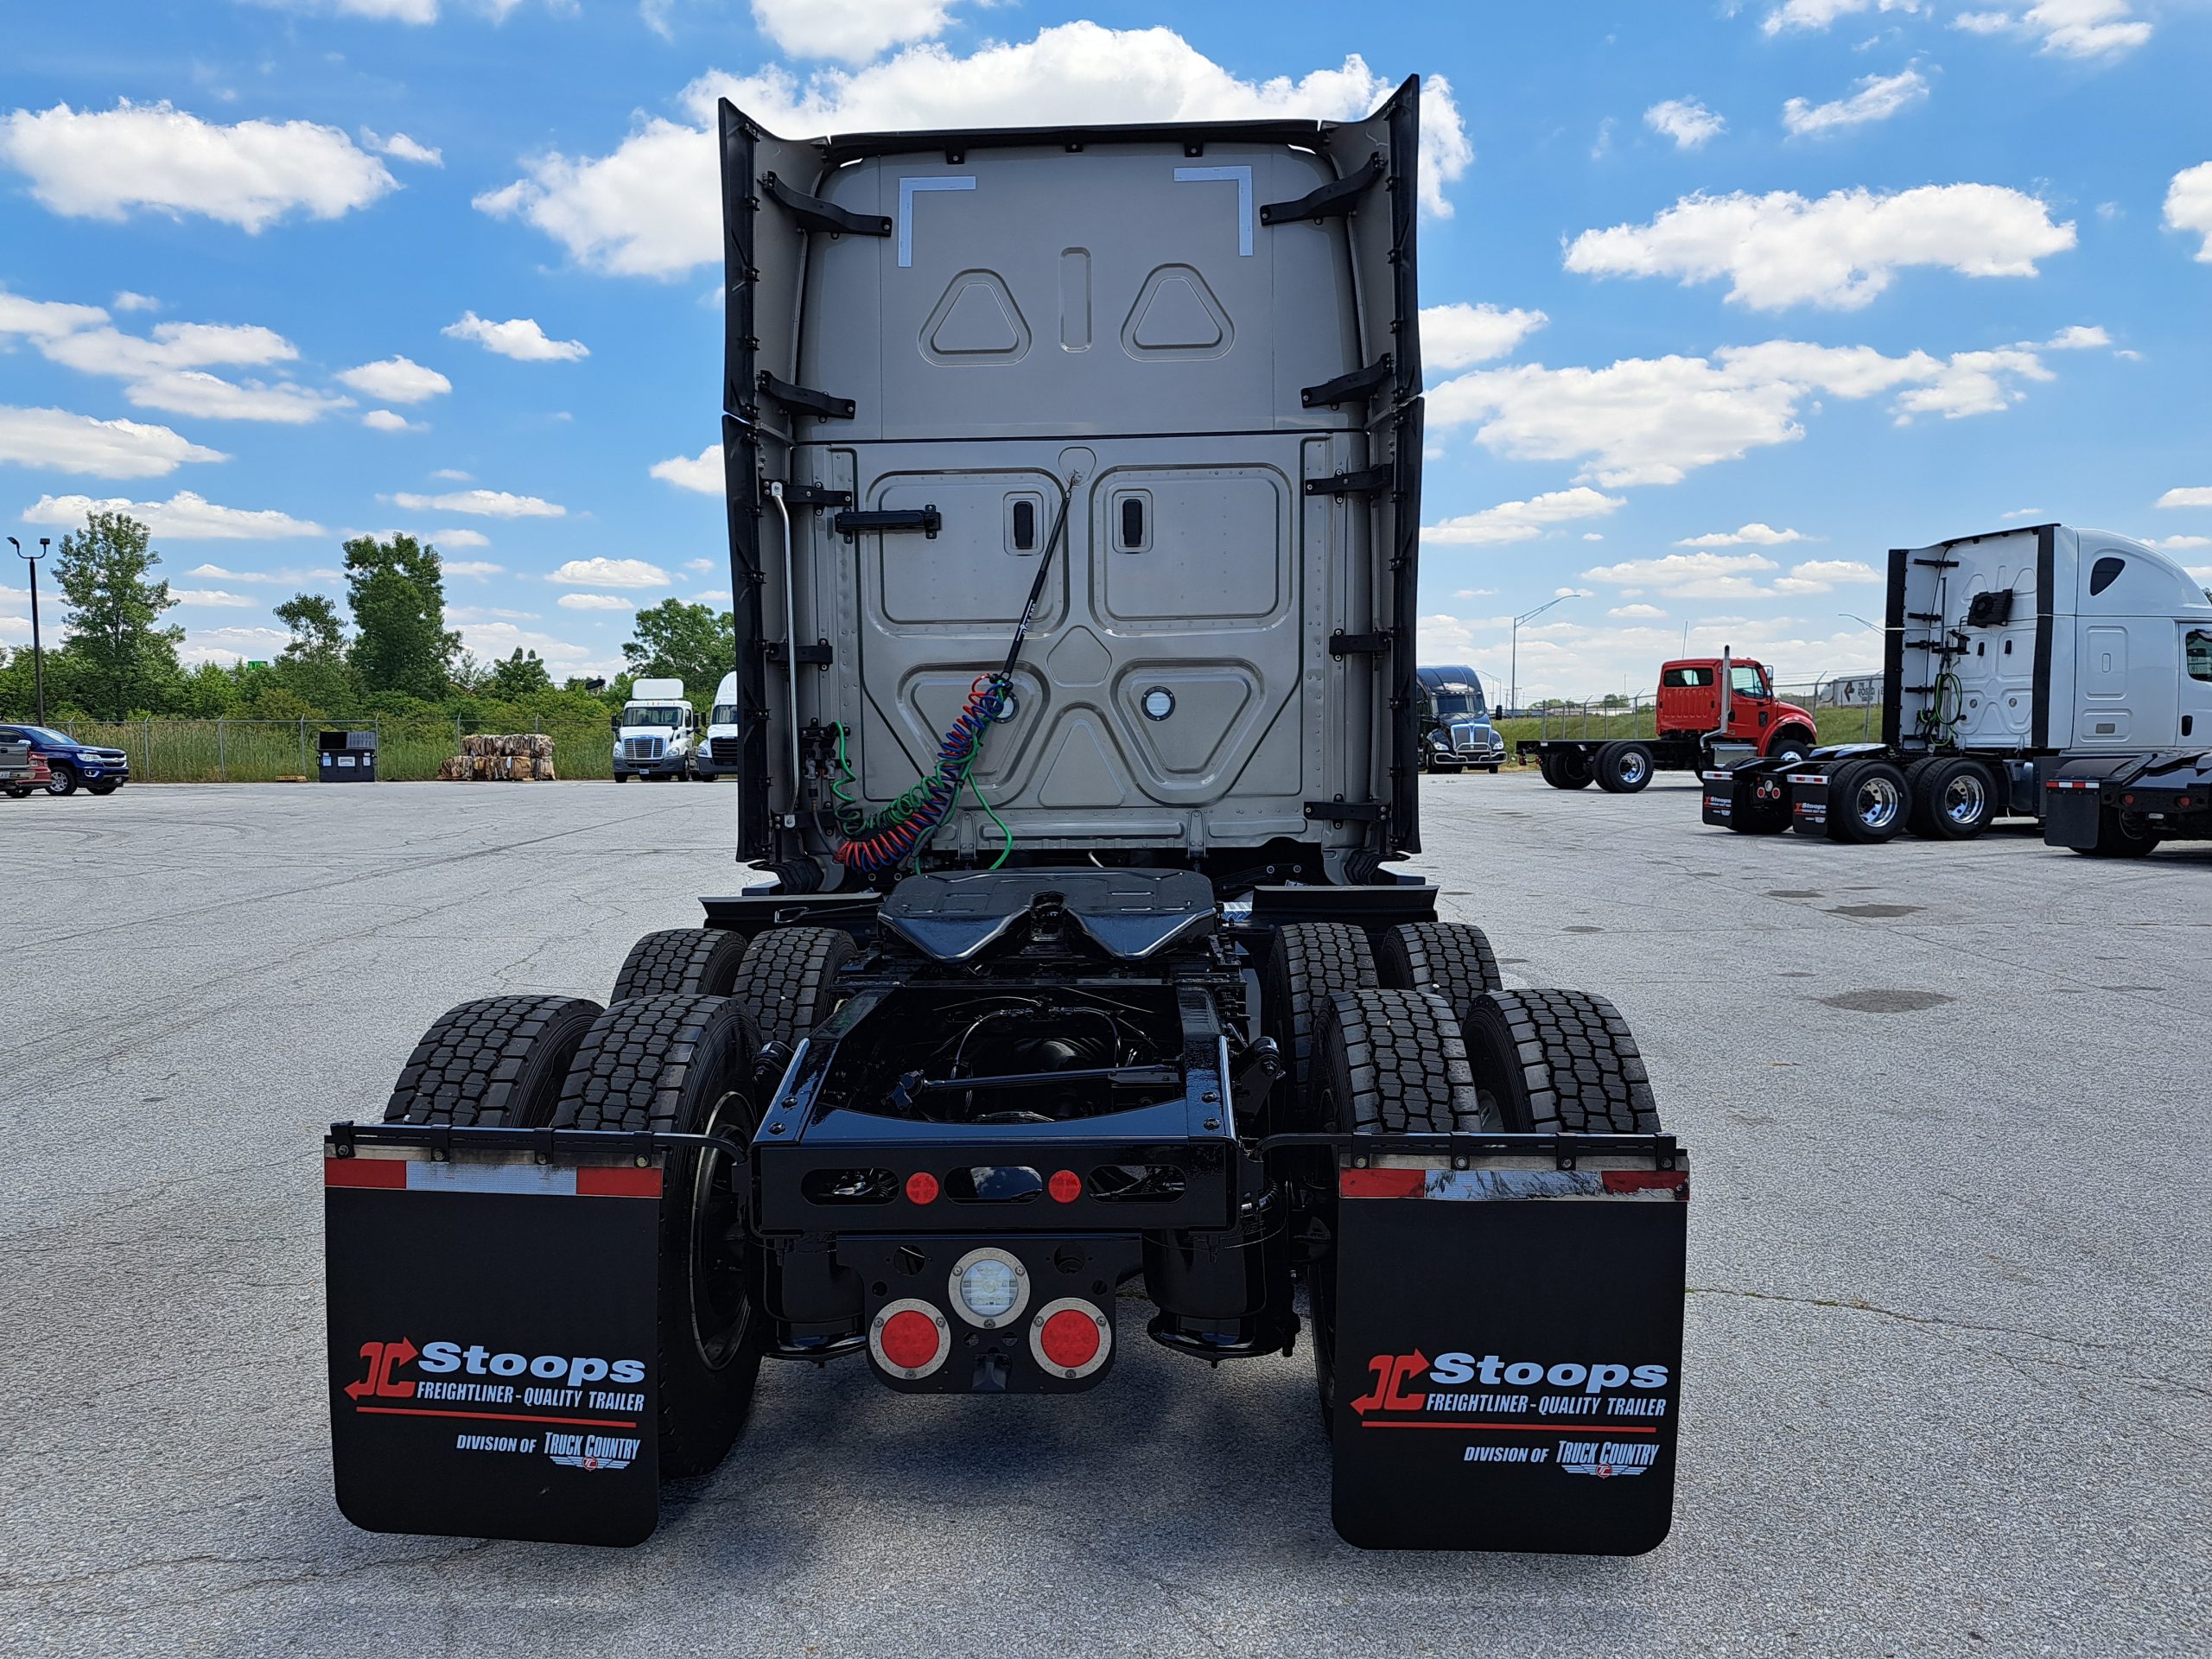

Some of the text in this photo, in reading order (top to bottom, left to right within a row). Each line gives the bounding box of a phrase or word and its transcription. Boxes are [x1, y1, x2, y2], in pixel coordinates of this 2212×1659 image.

[417, 1341, 646, 1387] Stoops
[1429, 1351, 1669, 1394] Stoops
[588, 1390, 645, 1412] TRAILER
[1606, 1397, 1667, 1417] TRAILER
[455, 1431, 641, 1460] DIVISION OF TRUCK COUNTRY
[1463, 1440, 1661, 1466] DIVISION OF TRUCK COUNTRY
